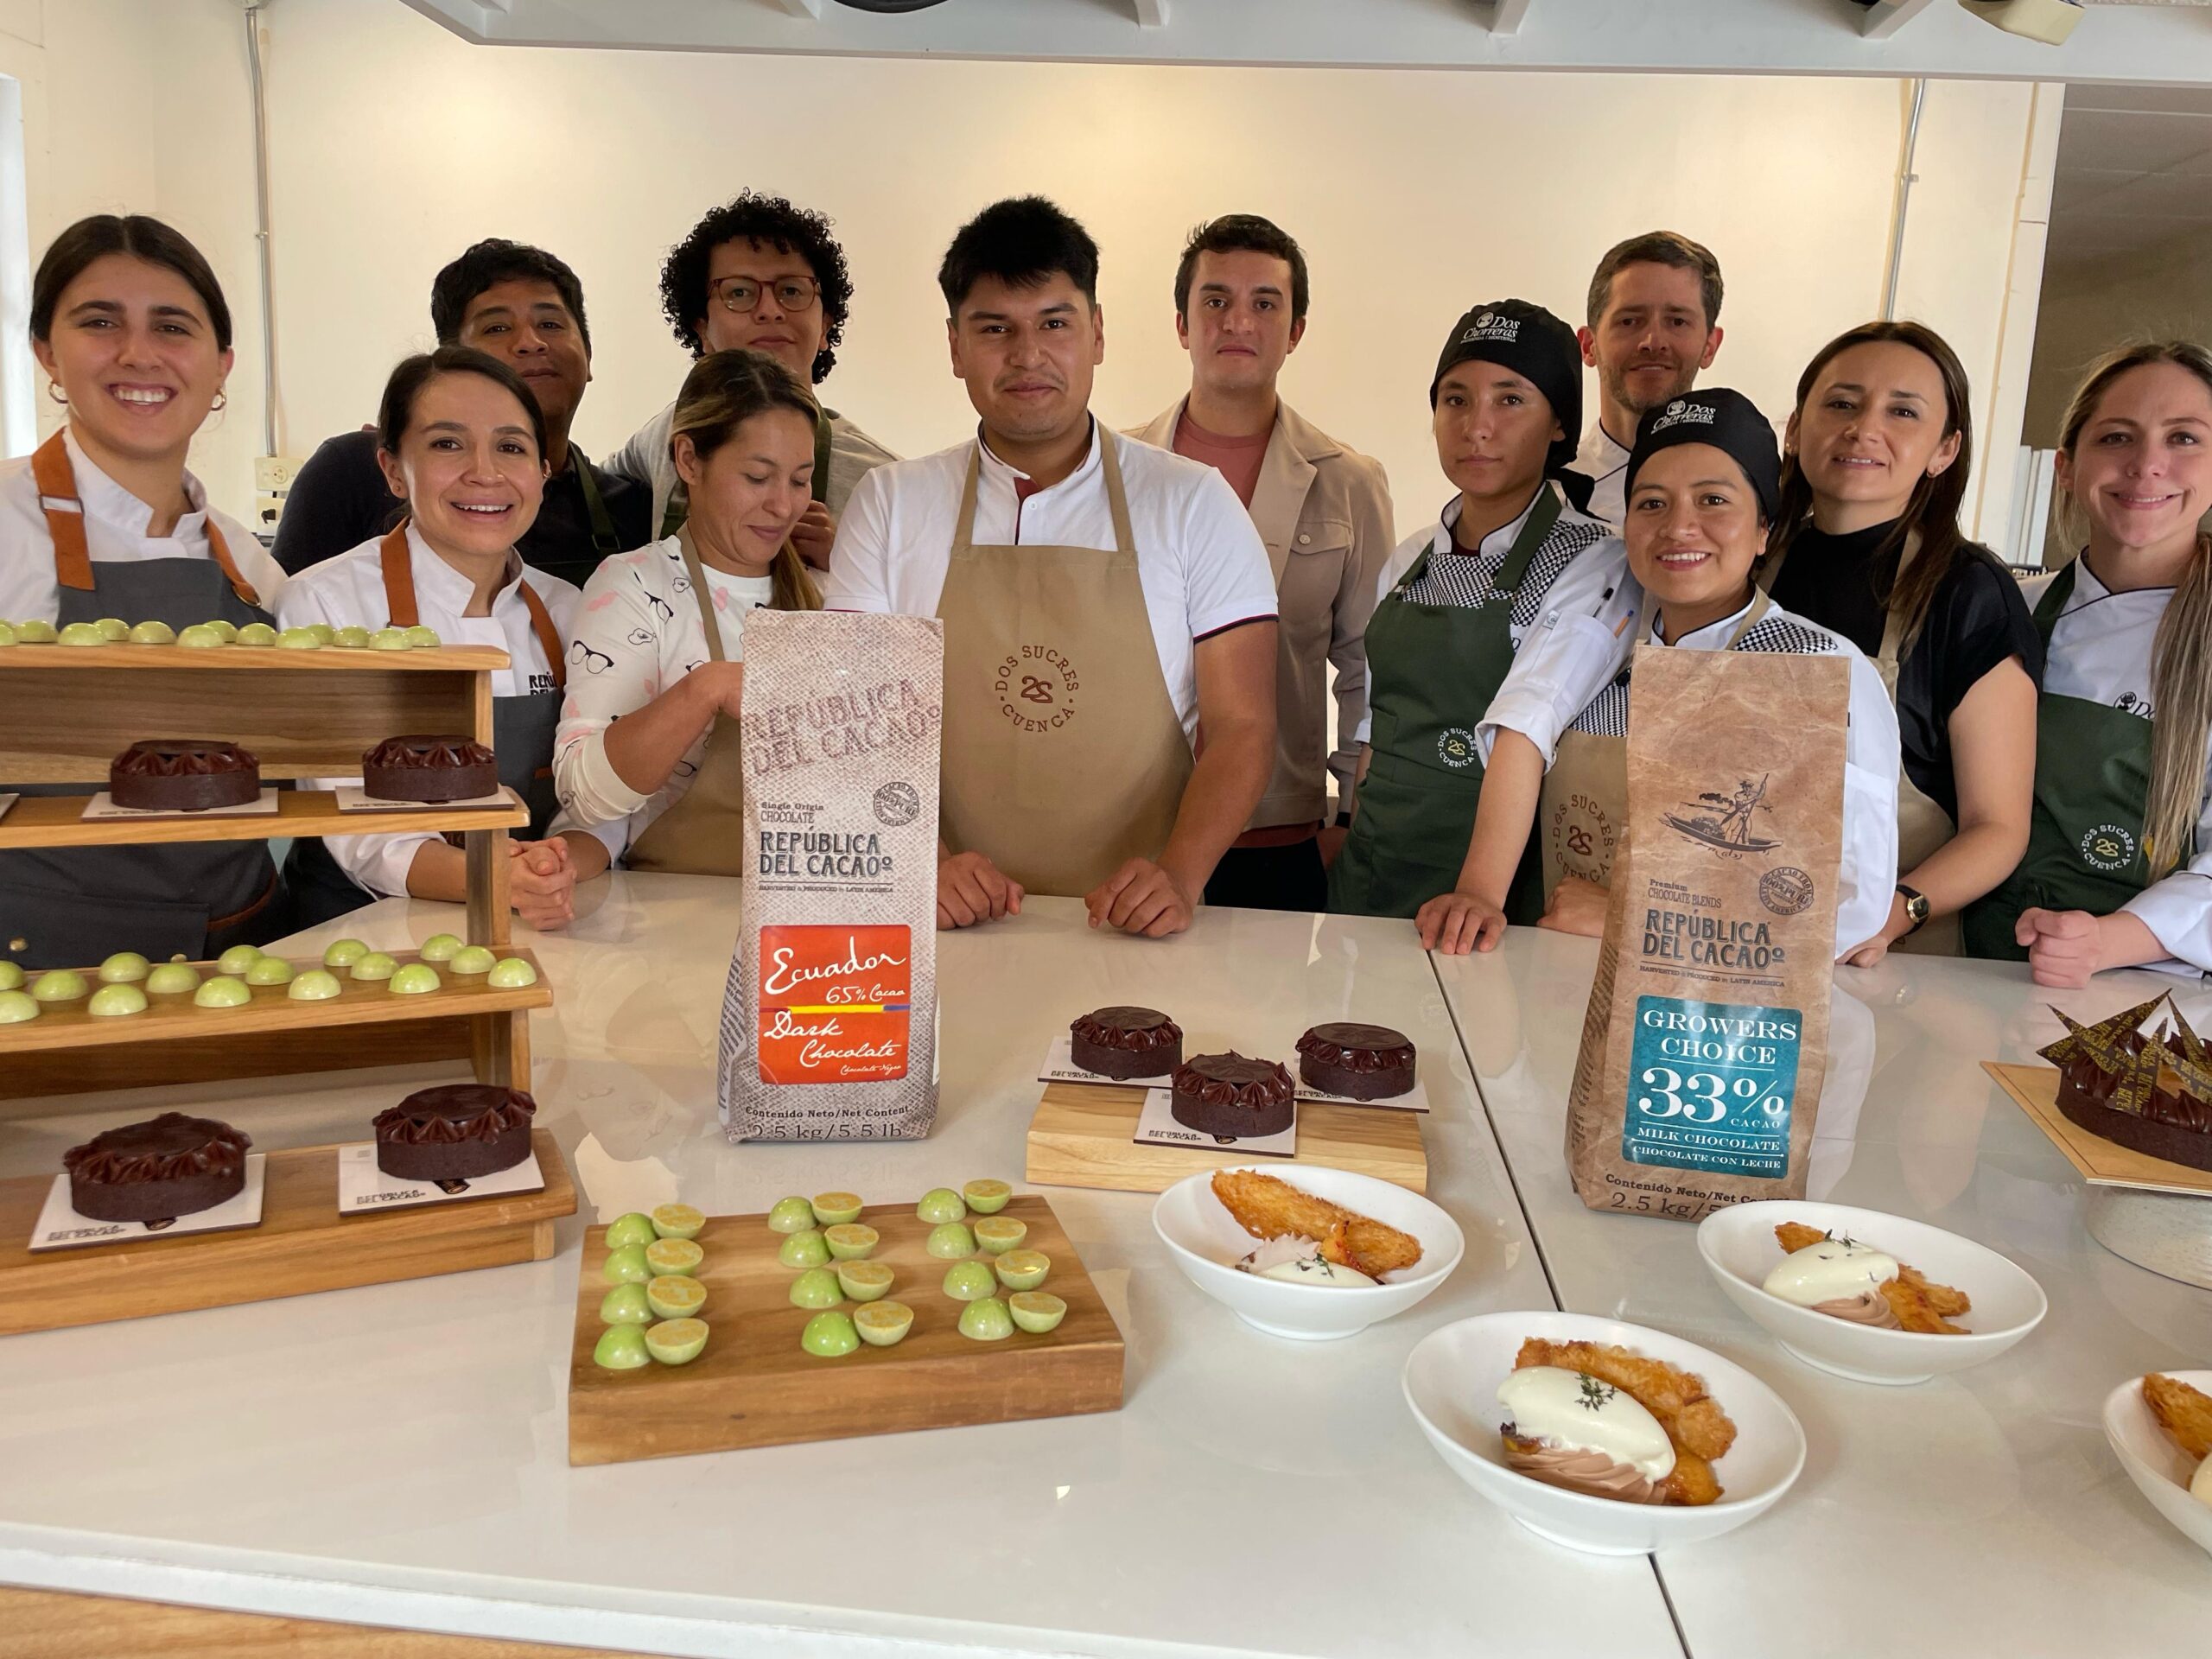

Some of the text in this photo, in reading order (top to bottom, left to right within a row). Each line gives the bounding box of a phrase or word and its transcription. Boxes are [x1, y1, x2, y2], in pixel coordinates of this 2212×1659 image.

[1463, 327, 1518, 340] Chorreras
[1490, 316, 1521, 330] Dos
[1686, 404, 1716, 415] Dos
[995, 645, 1079, 692] DOS SUCRES
[1002, 704, 1075, 733] CUENCA
[1437, 728, 1478, 751] DOS SUCRES
[1439, 752, 1475, 768] CUENCA
[760, 810, 815, 823] CHOCOLATE
[761, 801, 824, 811] Single Origin
[1553, 794, 1614, 847] DOS SUCRES
[760, 825, 881, 856] REPÚBLICA
[2082, 824, 2134, 852] DOS SUCRES
[760, 853, 800, 876] DEL
[1556, 851, 1611, 883] CUENCA
[2084, 852, 2131, 871] CUENCA
[1648, 887, 1722, 908] CHOCOLATE BLENDS
[1649, 879, 1688, 892] Premium
[1645, 908, 1772, 946] REPÚBLICA
[1642, 932, 1685, 961] DEL
[764, 935, 906, 995] Ecuador
[1639, 964, 1680, 976] HARVESTED
[1751, 979, 1785, 988] AMERICA
[825, 983, 906, 1004] 65% Cacao
[763, 1010, 844, 1040] Dark
[1643, 1008, 1797, 1041] GROWERS
[798, 1039, 902, 1068] Chocolate
[1660, 1036, 1777, 1065] CHOICE
[1638, 1066, 1785, 1123] 33%
[745, 1105, 909, 1119] Contenido Neto/Net Content
[1730, 1117, 1781, 1129] CACAO
[878, 1123, 902, 1138] lb
[1637, 1126, 1781, 1152] MILK CHOCOLATE
[1632, 1145, 1782, 1169] CHOCOLATE CON LECHE
[1605, 1173, 1673, 1194] Contenido
[1675, 1186, 1737, 1204] Neto/Net
[1611, 1192, 1651, 1211] 2.5
